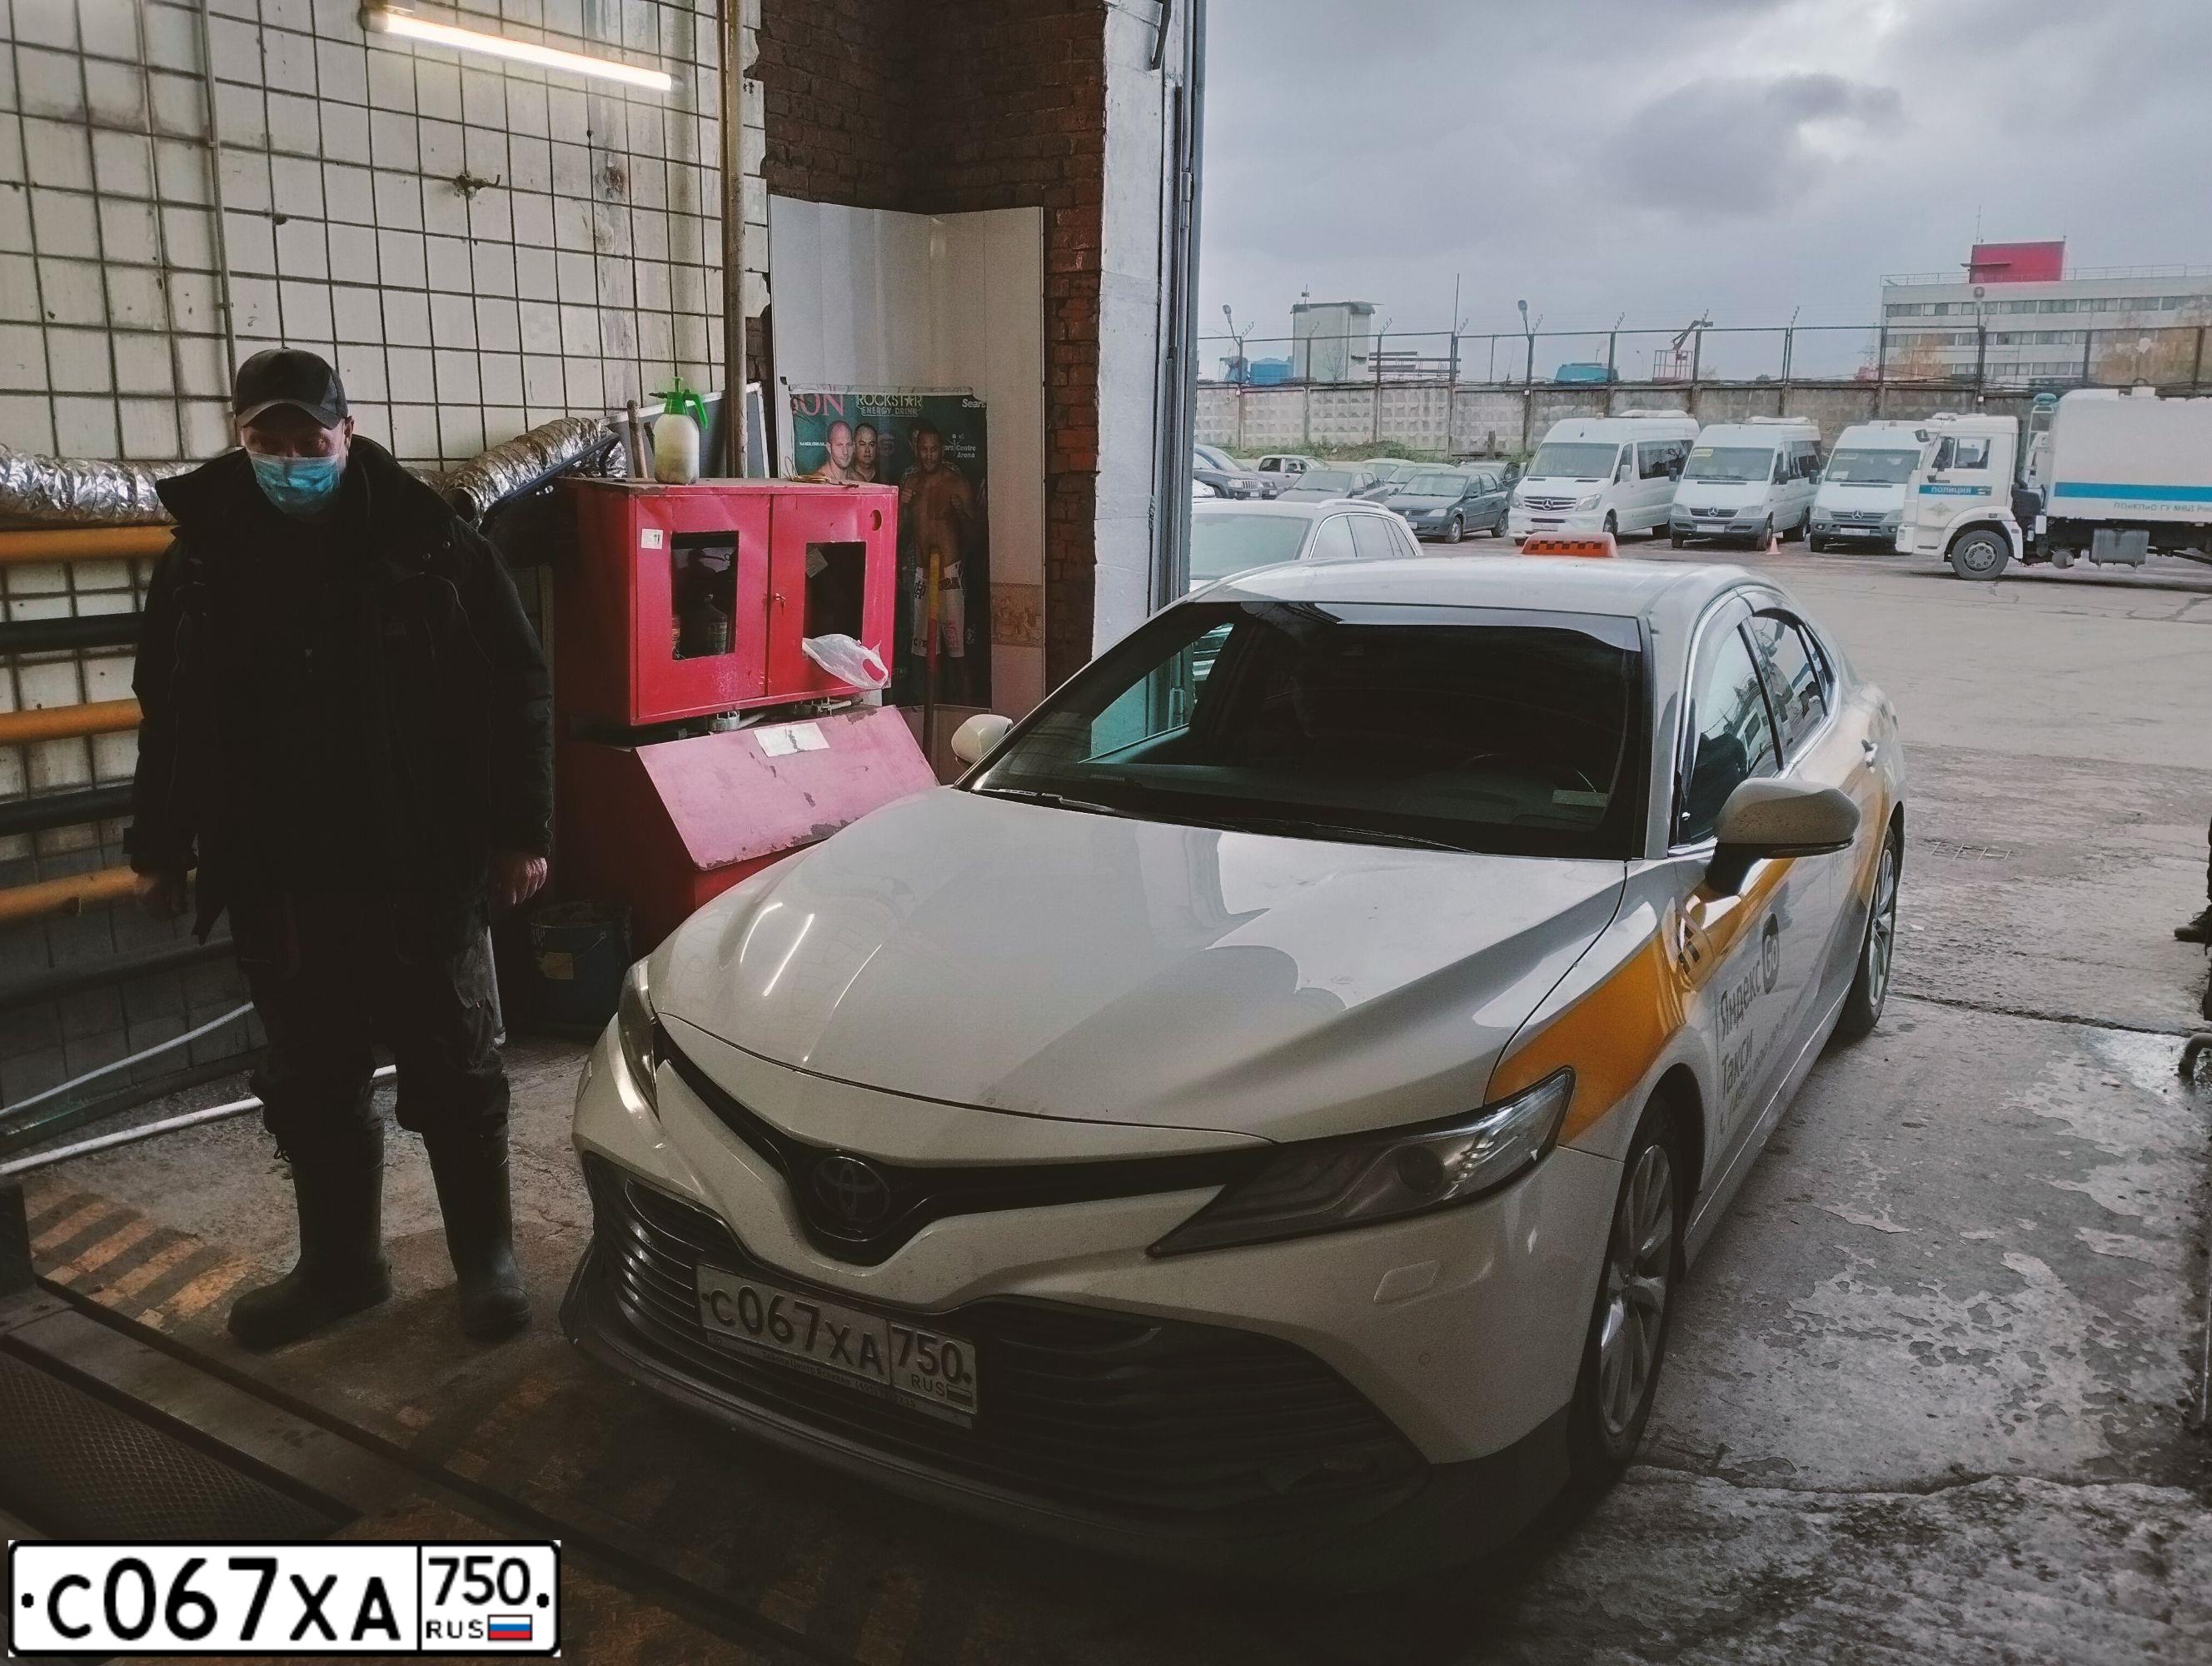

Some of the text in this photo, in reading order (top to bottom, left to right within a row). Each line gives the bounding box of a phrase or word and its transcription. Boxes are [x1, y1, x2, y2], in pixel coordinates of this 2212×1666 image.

[861, 407, 891, 415] ENERGY
[2174, 504, 2194, 512] МВД
[1720, 959, 1761, 1041] Яндекс
[1721, 1029, 1753, 1100] Такси
[890, 1324, 964, 1383] 750
[910, 1374, 945, 1398] RUS
